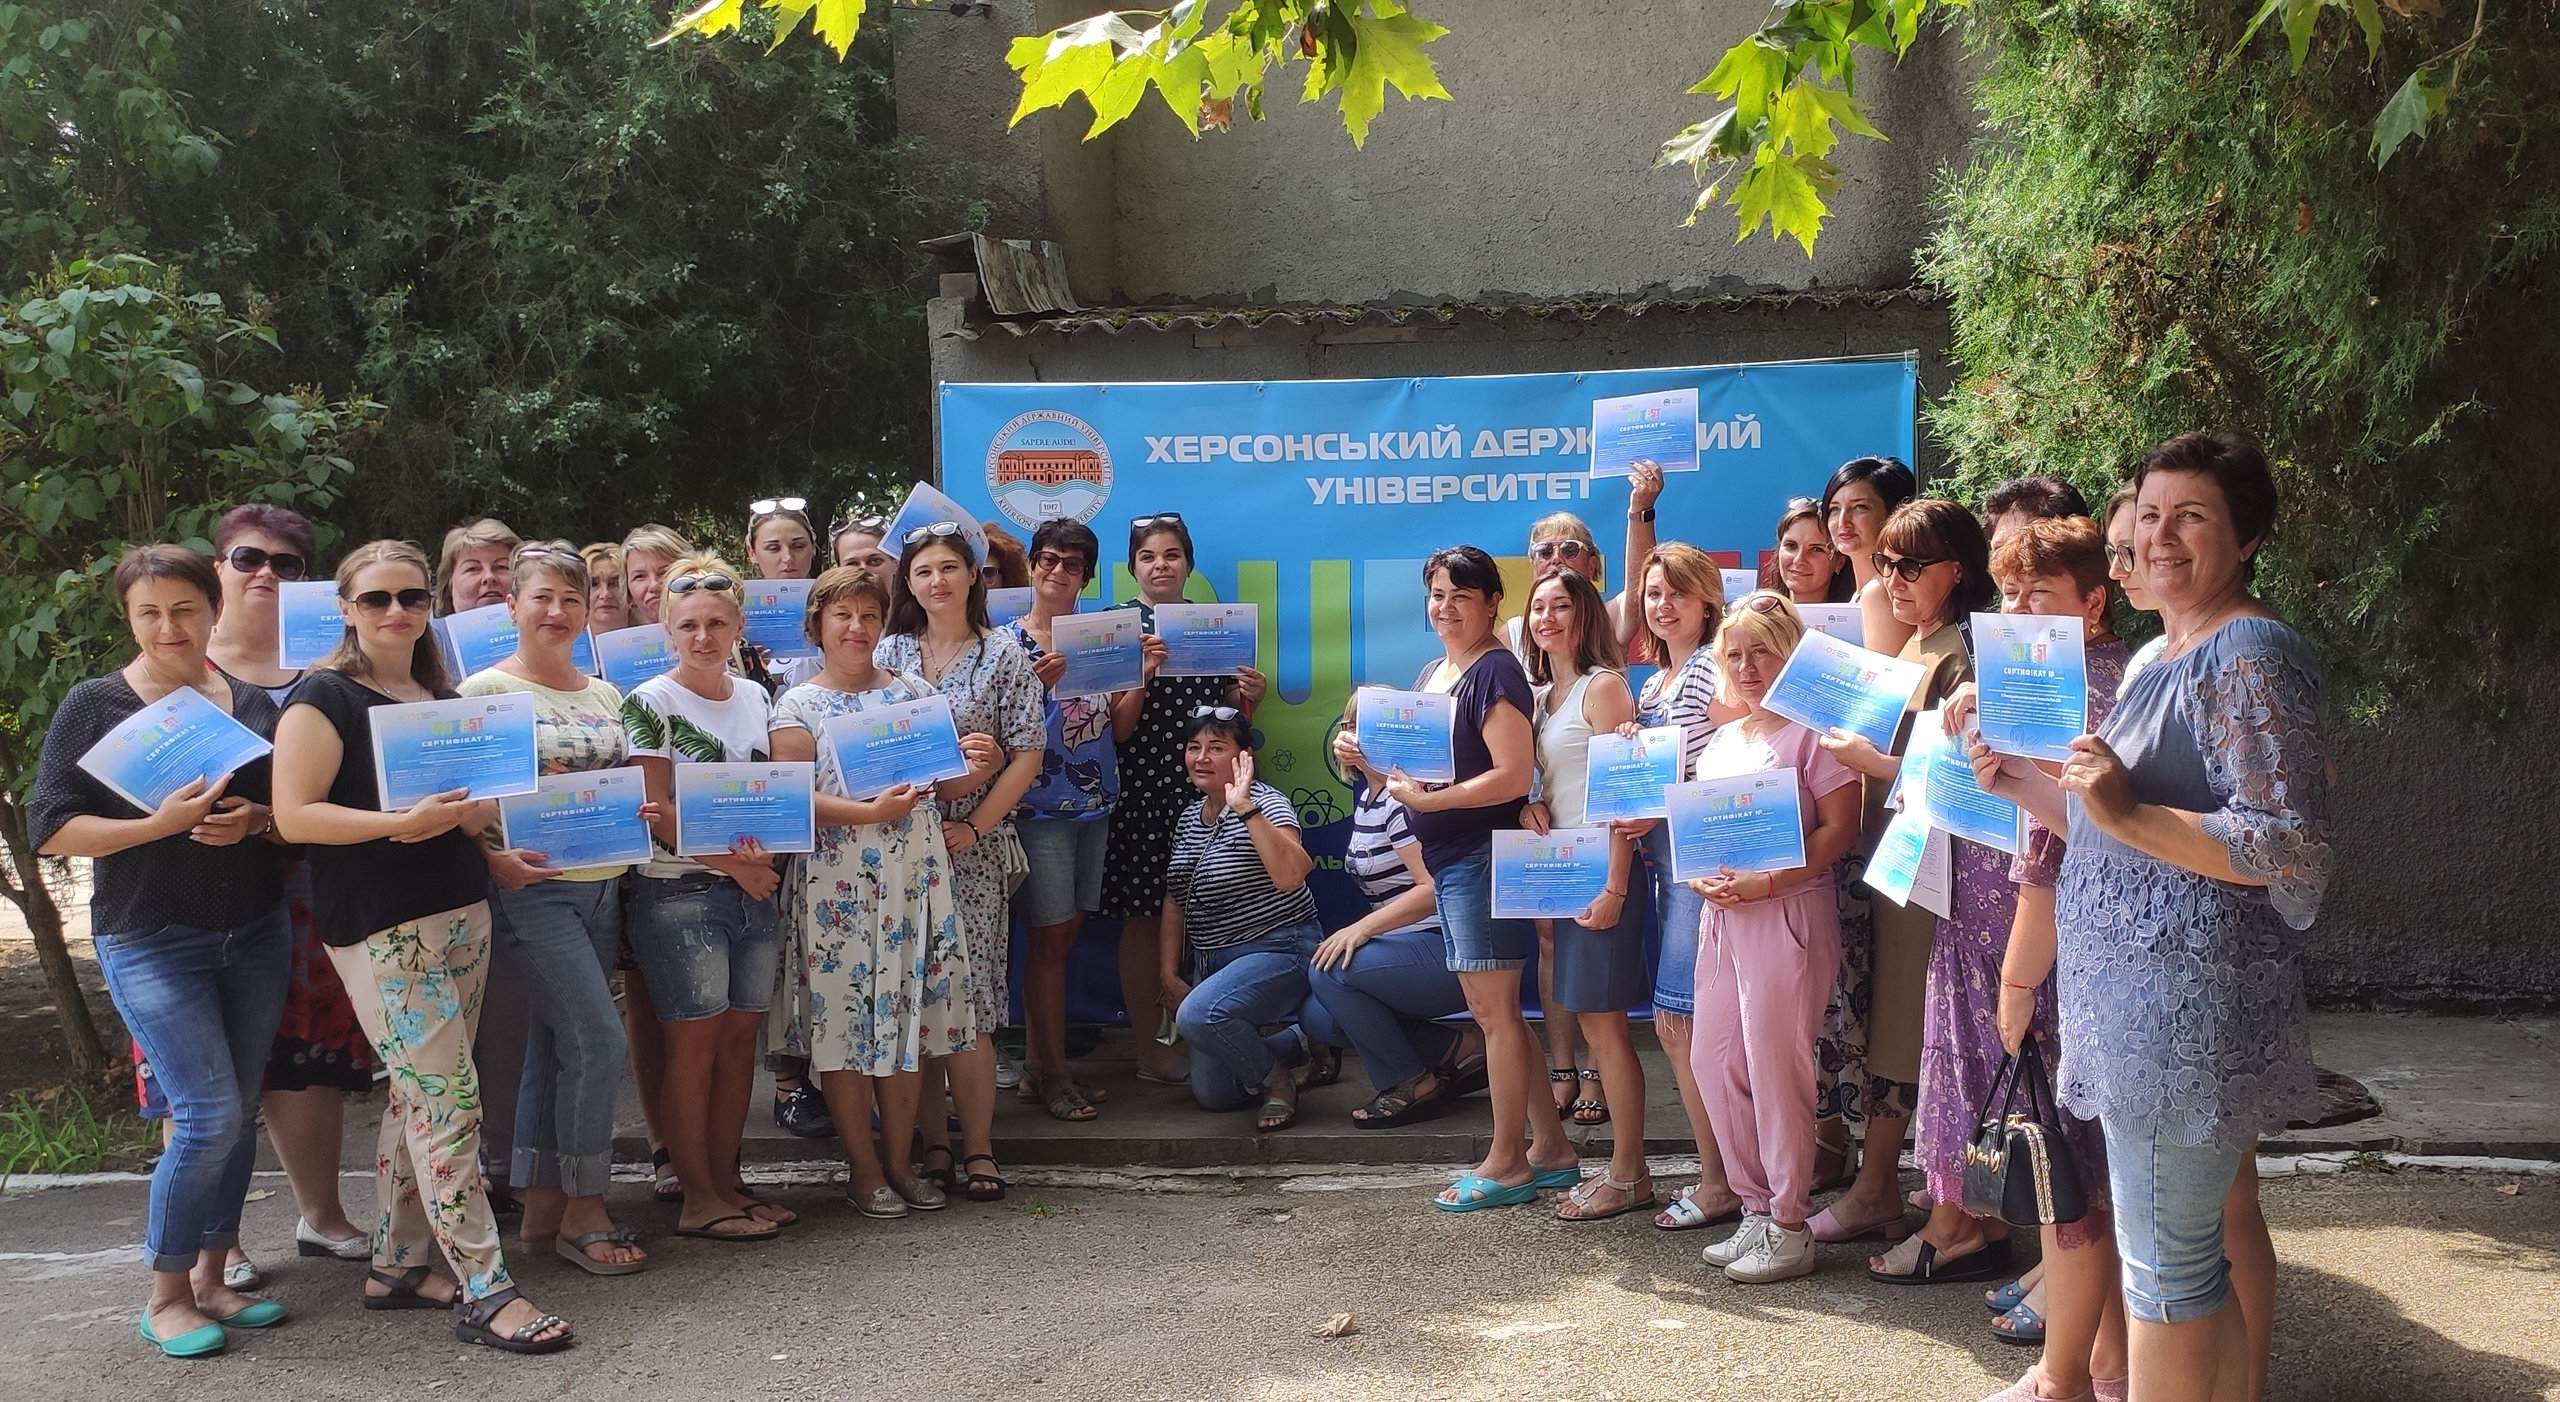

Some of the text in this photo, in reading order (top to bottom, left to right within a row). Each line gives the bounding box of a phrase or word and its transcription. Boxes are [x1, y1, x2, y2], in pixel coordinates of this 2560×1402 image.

[1144, 424, 1462, 464] ХЕРСОНСЬКИЙ
[1471, 413, 1762, 458] ДЕРЖИЙ
[1306, 471, 1590, 505] УНІВЕРСИТЕТ
[998, 498, 1032, 528] KHERSON
[421, 736, 482, 748] СЕРТИФІКАТ
[866, 734, 912, 748] СЕРТИФІКАТ
[541, 806, 596, 819] СЕРТИФІКАТ
[1703, 811, 1753, 823] СЕРТИФІКАТ
